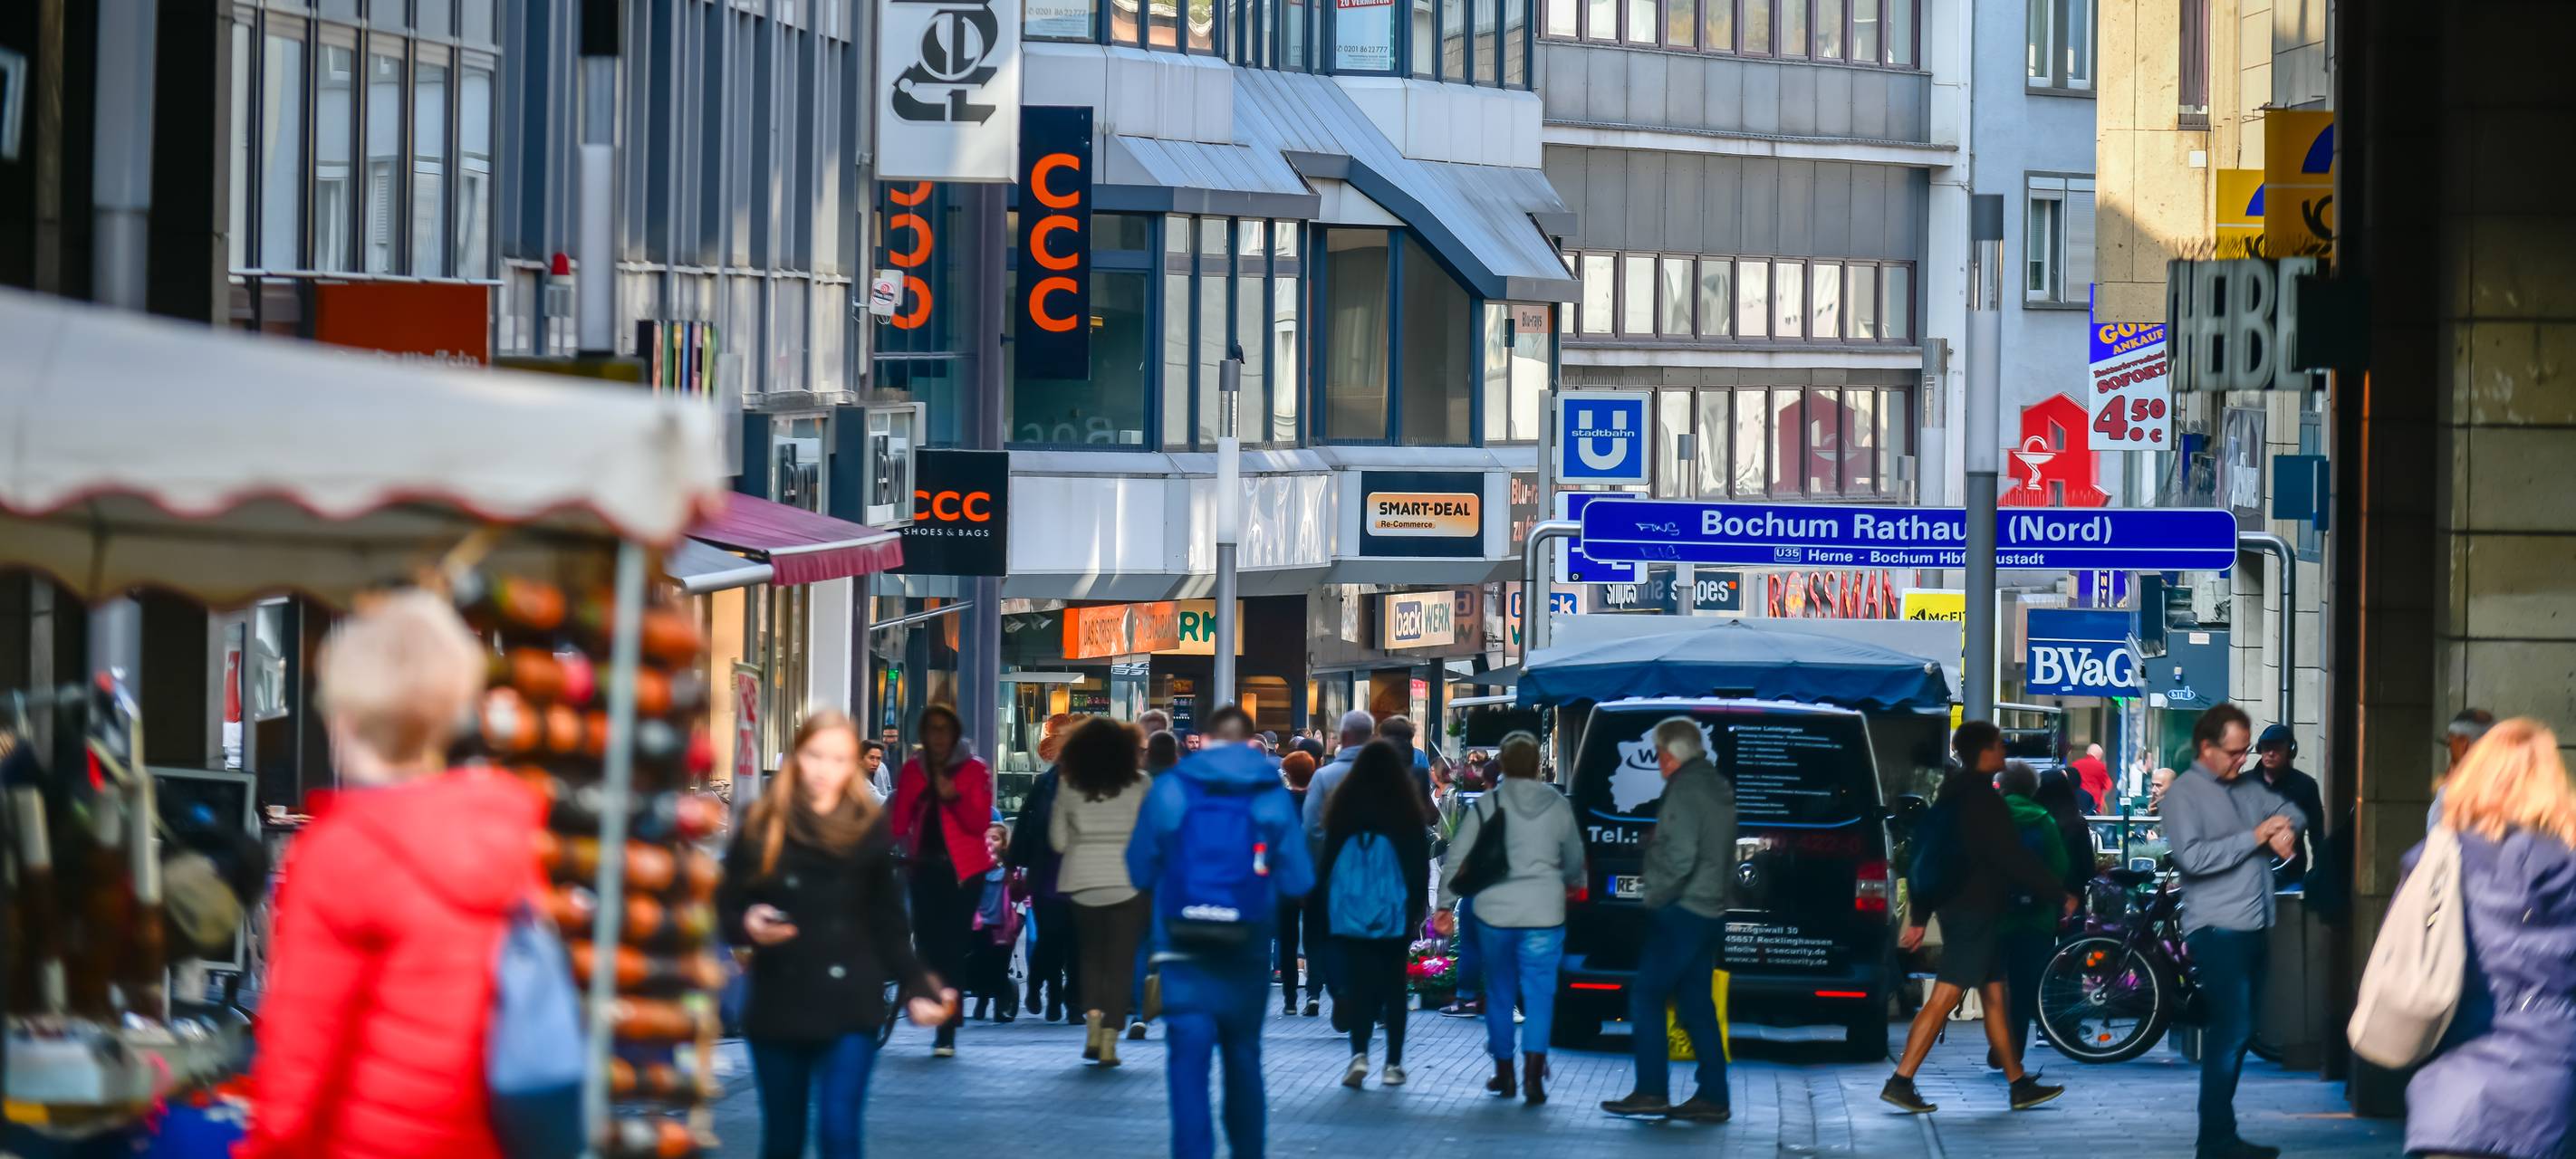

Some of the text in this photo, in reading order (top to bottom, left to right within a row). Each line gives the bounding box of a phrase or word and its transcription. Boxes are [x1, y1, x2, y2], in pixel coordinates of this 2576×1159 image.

[1522, 311, 1543, 331] Blu-rays
[2113, 329, 2164, 355] ANKAUF
[2097, 361, 2167, 394] SOFORT
[1572, 429, 1635, 437] stadtbahn
[1379, 502, 1471, 516] SMART-DEAL
[1380, 520, 1433, 528] Re-Commerce
[1701, 510, 2112, 543] Bochum Rathau (Nord)
[904, 528, 989, 537] SHOES & BAGS
[1776, 549, 1800, 558] U35
[1808, 550, 1853, 561] Herne
[1870, 551, 1933, 565] Bochum
[1939, 552, 1966, 564] Hbf
[1396, 608, 1420, 637] back
[1423, 603, 1451, 634] WERK
[2032, 647, 2136, 687] BVaG
[1588, 826, 1639, 843] Tel.:
[1725, 925, 1783, 934] Herzogswall
[1757, 936, 1832, 946] Recklinghausen
